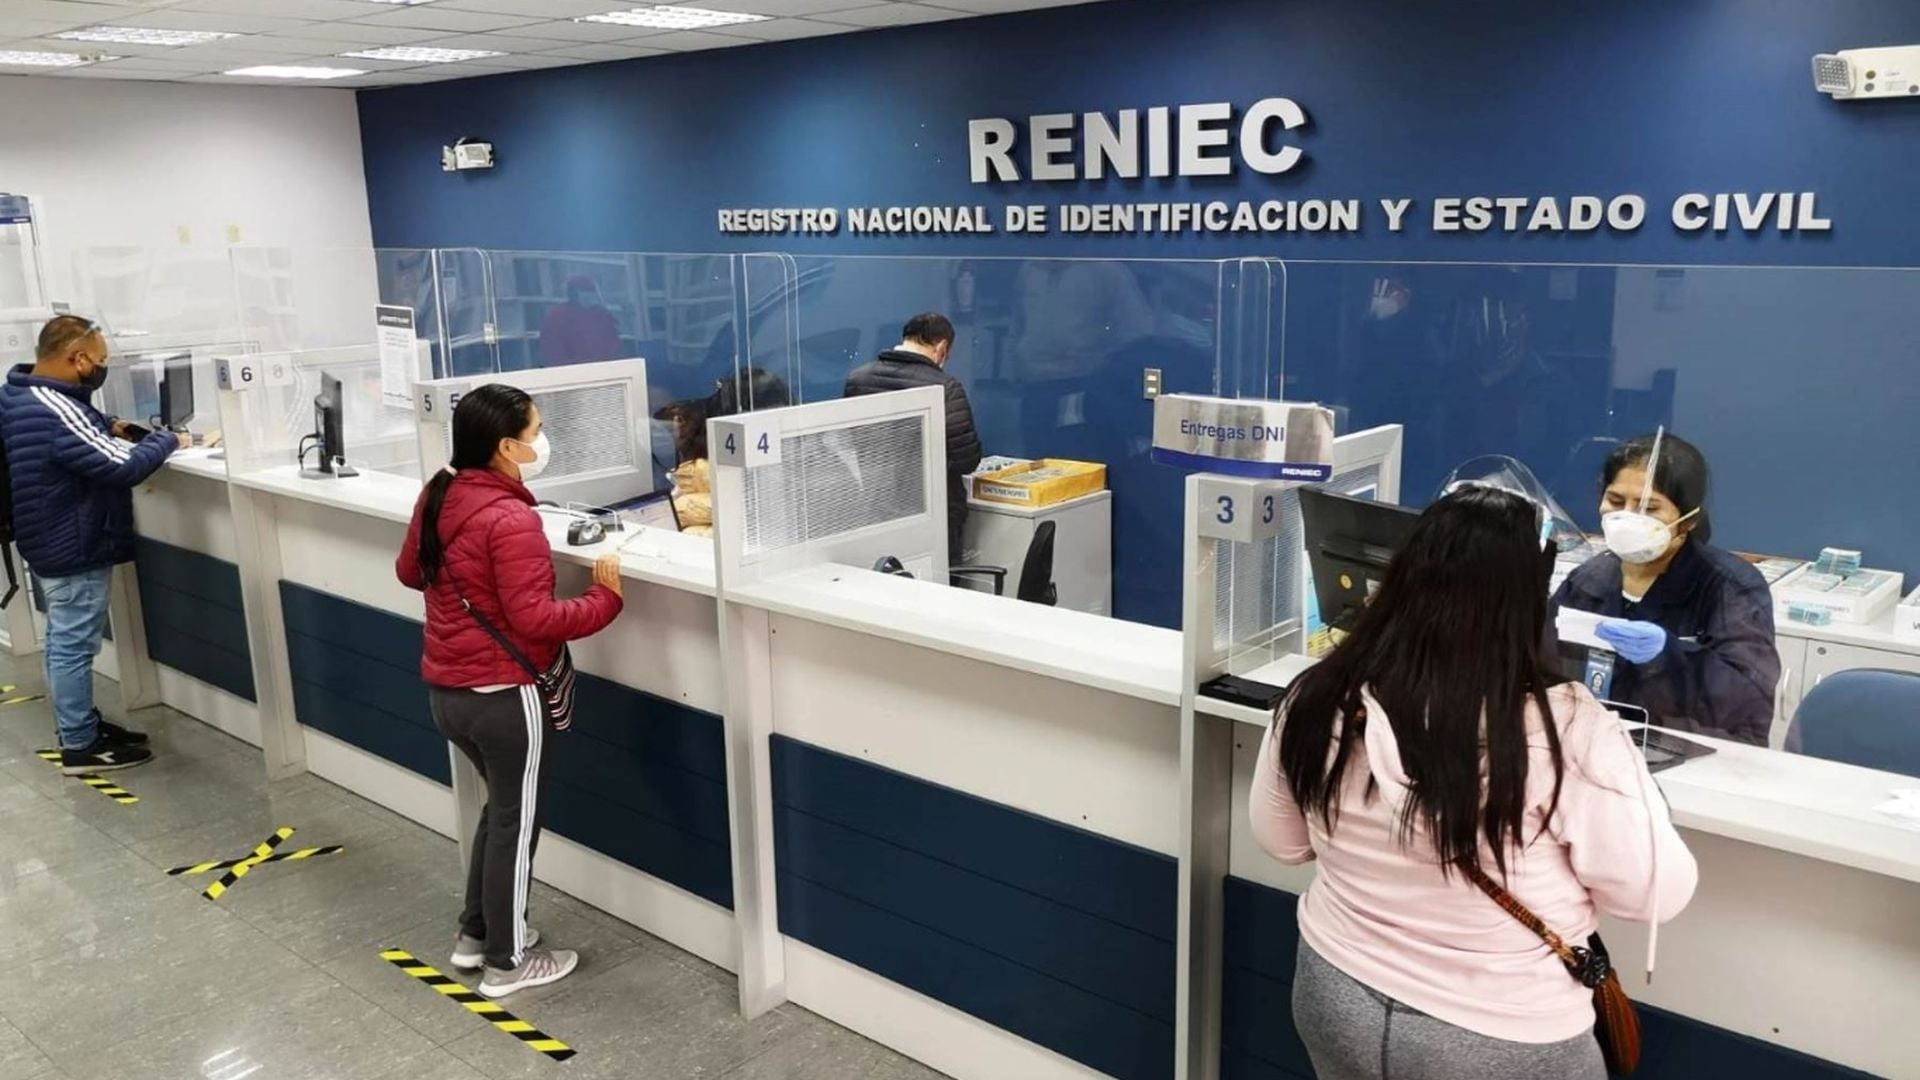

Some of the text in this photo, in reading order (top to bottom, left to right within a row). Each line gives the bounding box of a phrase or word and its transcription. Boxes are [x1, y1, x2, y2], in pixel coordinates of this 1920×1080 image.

[969, 98, 1304, 183] RENIEC
[718, 192, 1831, 232] REGISTRO NACIONAL DE IDENTIFICACION Y ESTADO CIVIL
[240, 366, 252, 382] 6
[424, 394, 433, 412] 5
[1181, 419, 1285, 442] Entregas DNI
[725, 432, 737, 455] 4
[757, 432, 770, 454] 4
[1281, 467, 1322, 477] RENIEC
[1216, 496, 1234, 524] 3
[1262, 495, 1274, 524] 3
